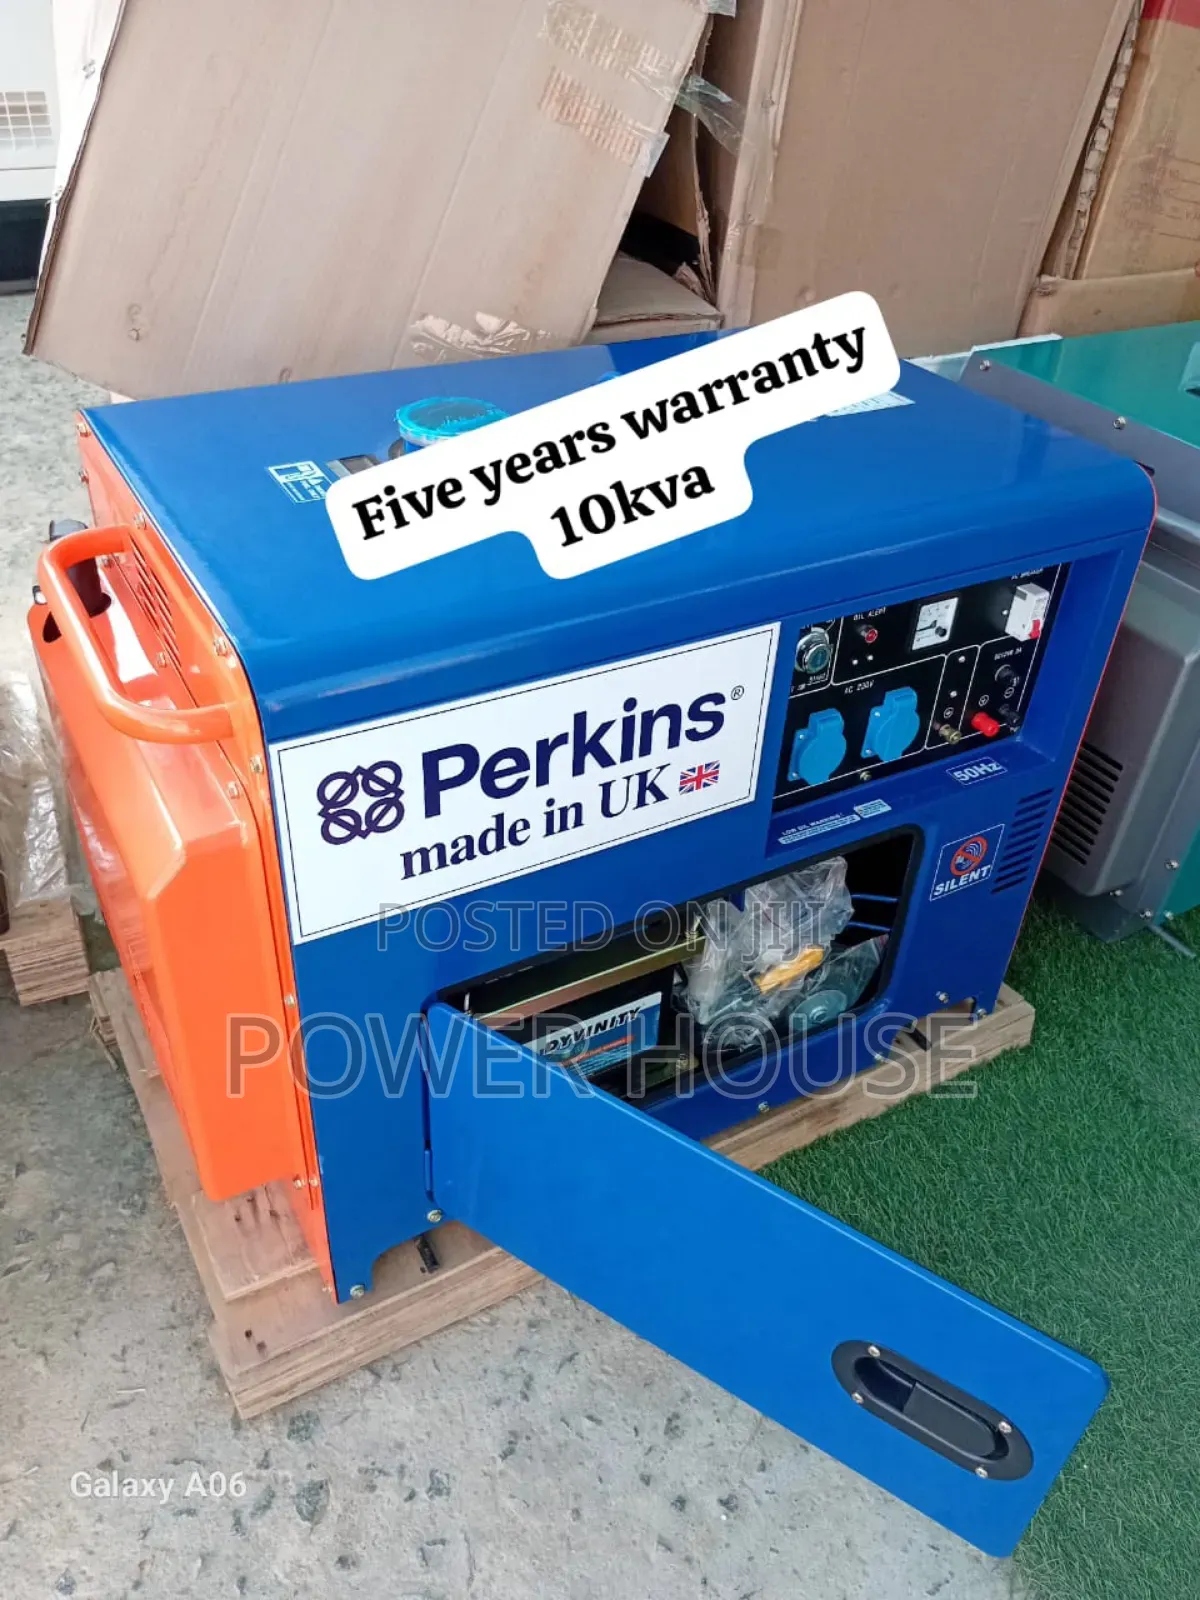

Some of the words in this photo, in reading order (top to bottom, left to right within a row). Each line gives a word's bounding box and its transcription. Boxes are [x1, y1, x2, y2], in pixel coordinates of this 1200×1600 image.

[421, 691, 726, 819] Perkins
[953, 762, 1003, 781] 50Hz
[400, 810, 531, 880] made
[543, 797, 584, 838] in
[598, 763, 669, 820] UK
[933, 864, 992, 897] SILENT
